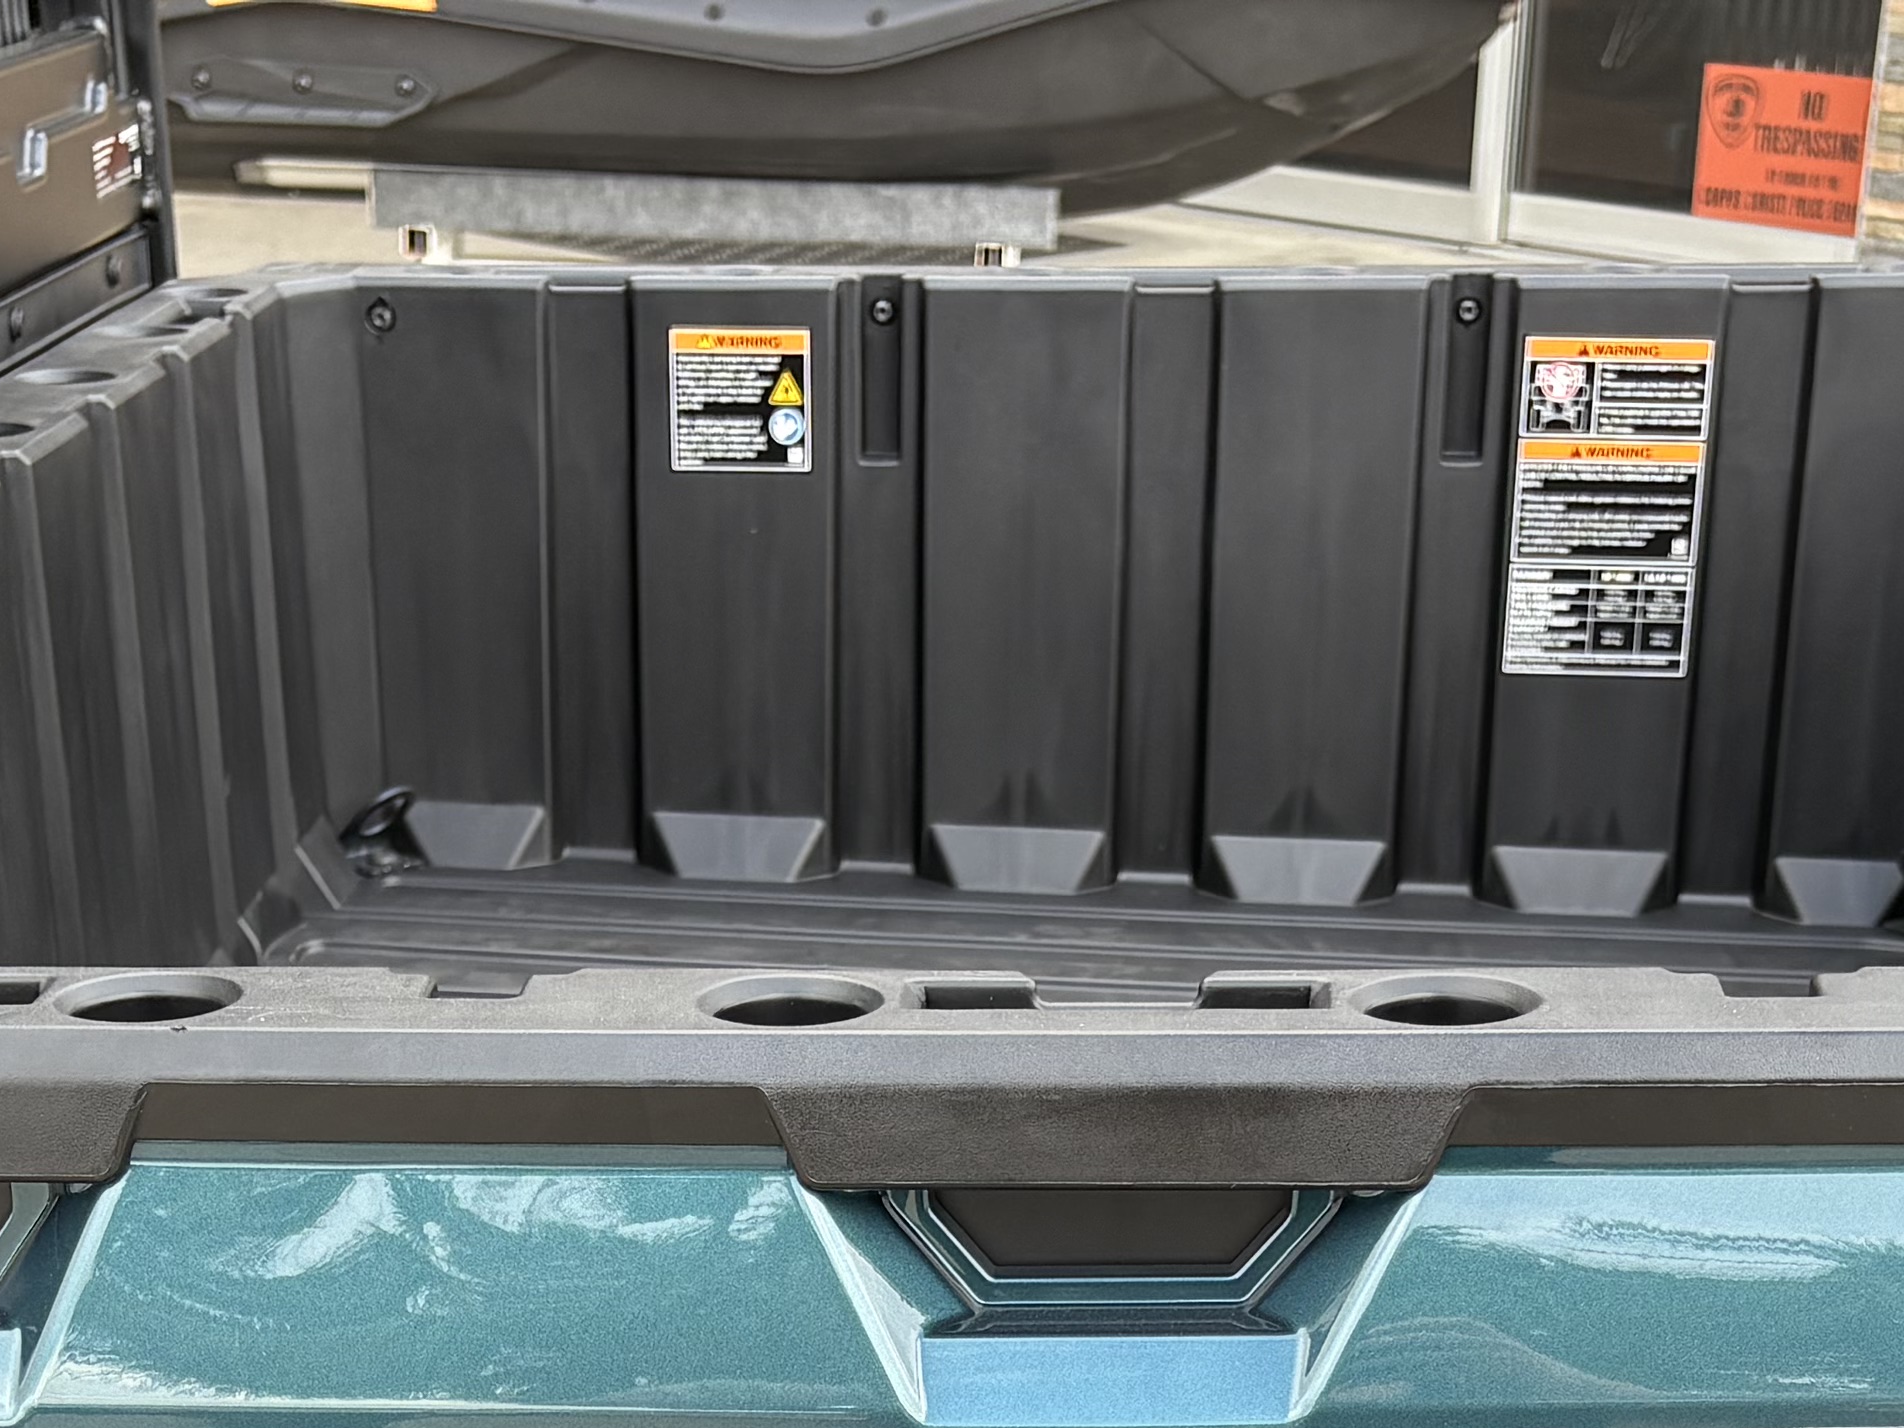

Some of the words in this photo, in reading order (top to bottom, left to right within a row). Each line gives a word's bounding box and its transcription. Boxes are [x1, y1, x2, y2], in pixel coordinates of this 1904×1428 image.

[1800, 89, 1828, 122] NO
[1753, 124, 1862, 163] TRESPASSING
[1592, 344, 1661, 358] WARNING
